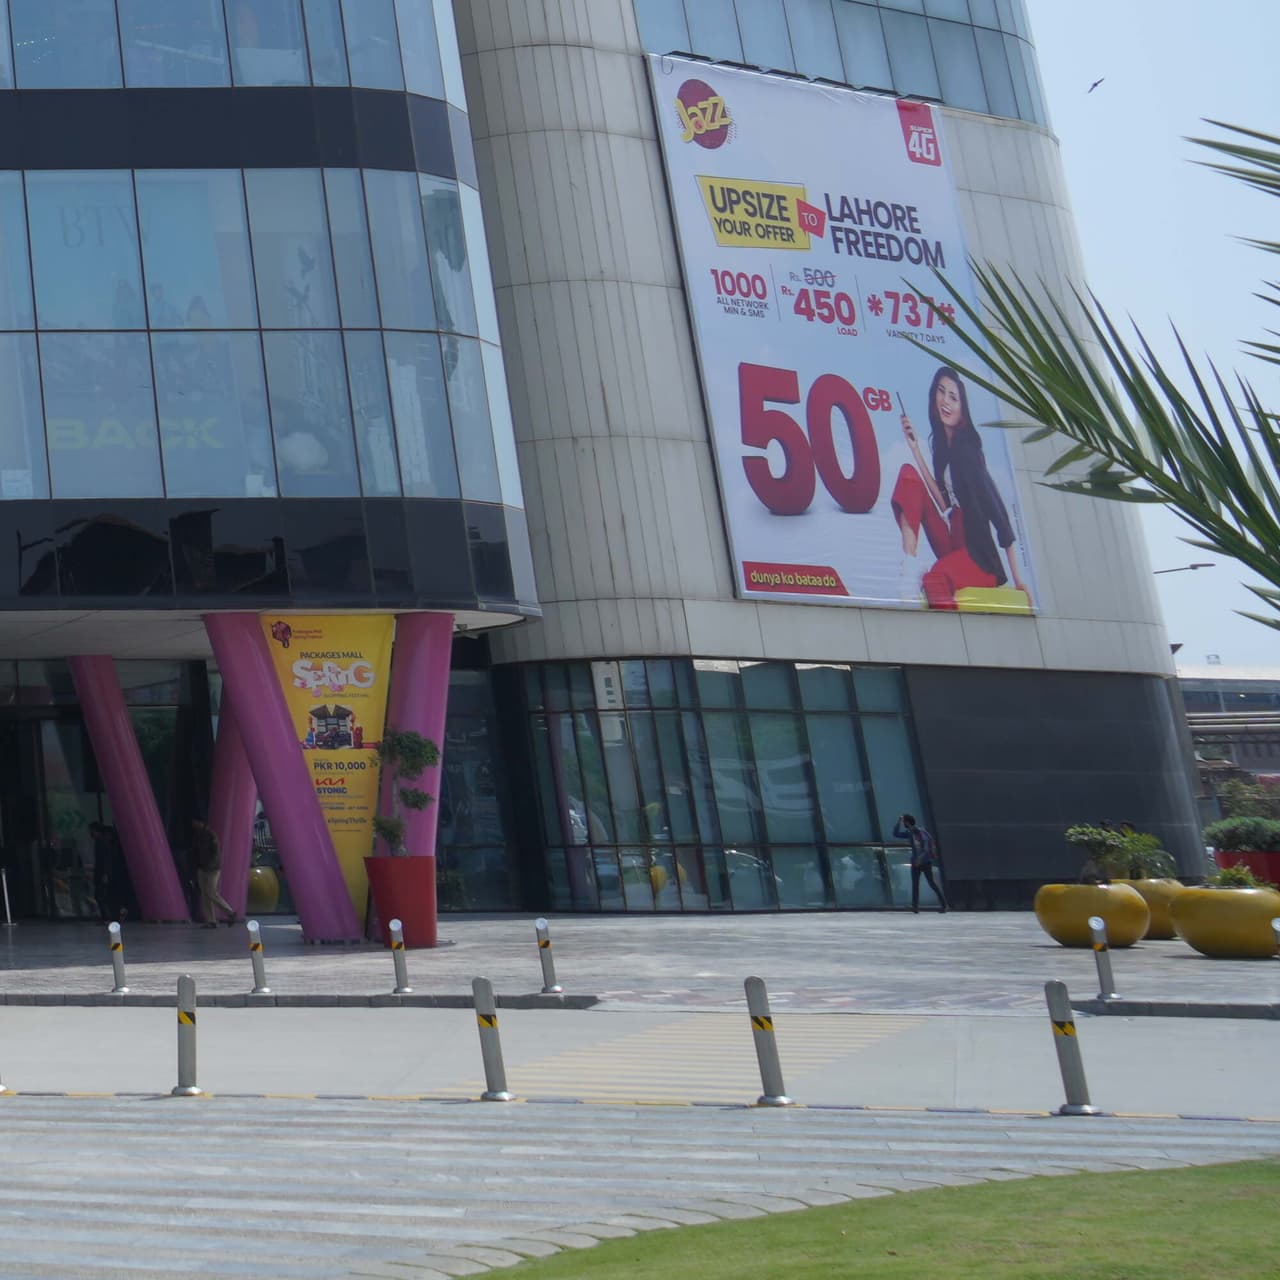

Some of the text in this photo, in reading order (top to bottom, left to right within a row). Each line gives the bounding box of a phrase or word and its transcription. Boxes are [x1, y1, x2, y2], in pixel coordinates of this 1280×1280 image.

[674, 96, 732, 143] Jazz
[908, 131, 935, 161] 4G
[709, 184, 791, 222] UPSIZE
[824, 193, 922, 234] LAHORE
[714, 217, 795, 243] YOUR OFFER
[802, 212, 818, 227] TO
[830, 225, 946, 269] FREEDOM
[710, 268, 768, 300] 1000
[803, 267, 837, 288] 500
[716, 297, 769, 311] ALL NETWORK
[724, 305, 765, 318] MIN & SMS
[781, 285, 856, 326] Rs. 450
[837, 327, 858, 337] LOAD
[863, 387, 892, 411] GB
[738, 362, 881, 516] 50
[750, 570, 781, 586] dunya
[781, 571, 793, 585] ko
[299, 651, 364, 660] PACKAGES MALL
[313, 762, 366, 771] PKR 10,000
[316, 786, 348, 794] STONIC
